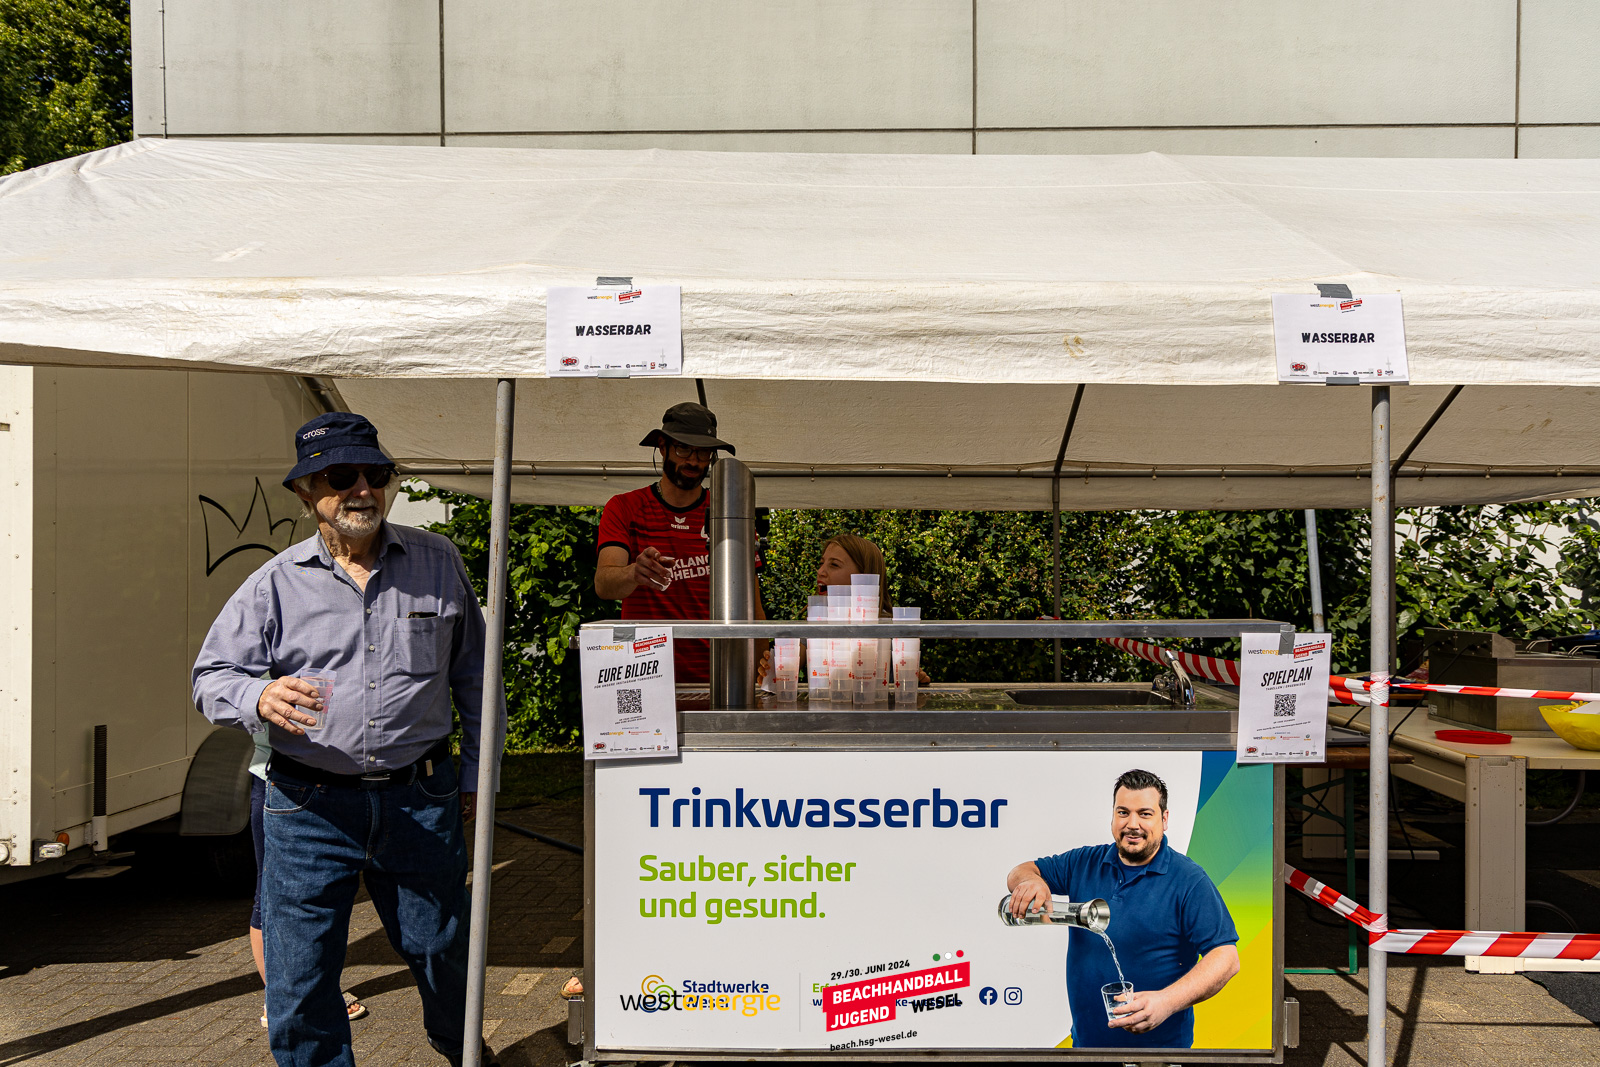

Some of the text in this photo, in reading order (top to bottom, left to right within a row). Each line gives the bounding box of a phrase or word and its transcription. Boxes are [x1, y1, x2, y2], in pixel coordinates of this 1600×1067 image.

[575, 324, 651, 336] WASSERBAR
[1301, 332, 1375, 343] WASSERBAR
[586, 643, 624, 651] westenergie
[597, 660, 659, 684] EURE BILDER
[1261, 666, 1313, 687] SPIELPLAN
[639, 787, 1008, 828] Trinkwasserbar
[639, 855, 856, 887] Sauber, sicher
[639, 892, 826, 924] und gesund.
[682, 979, 769, 993] Stadtwerke
